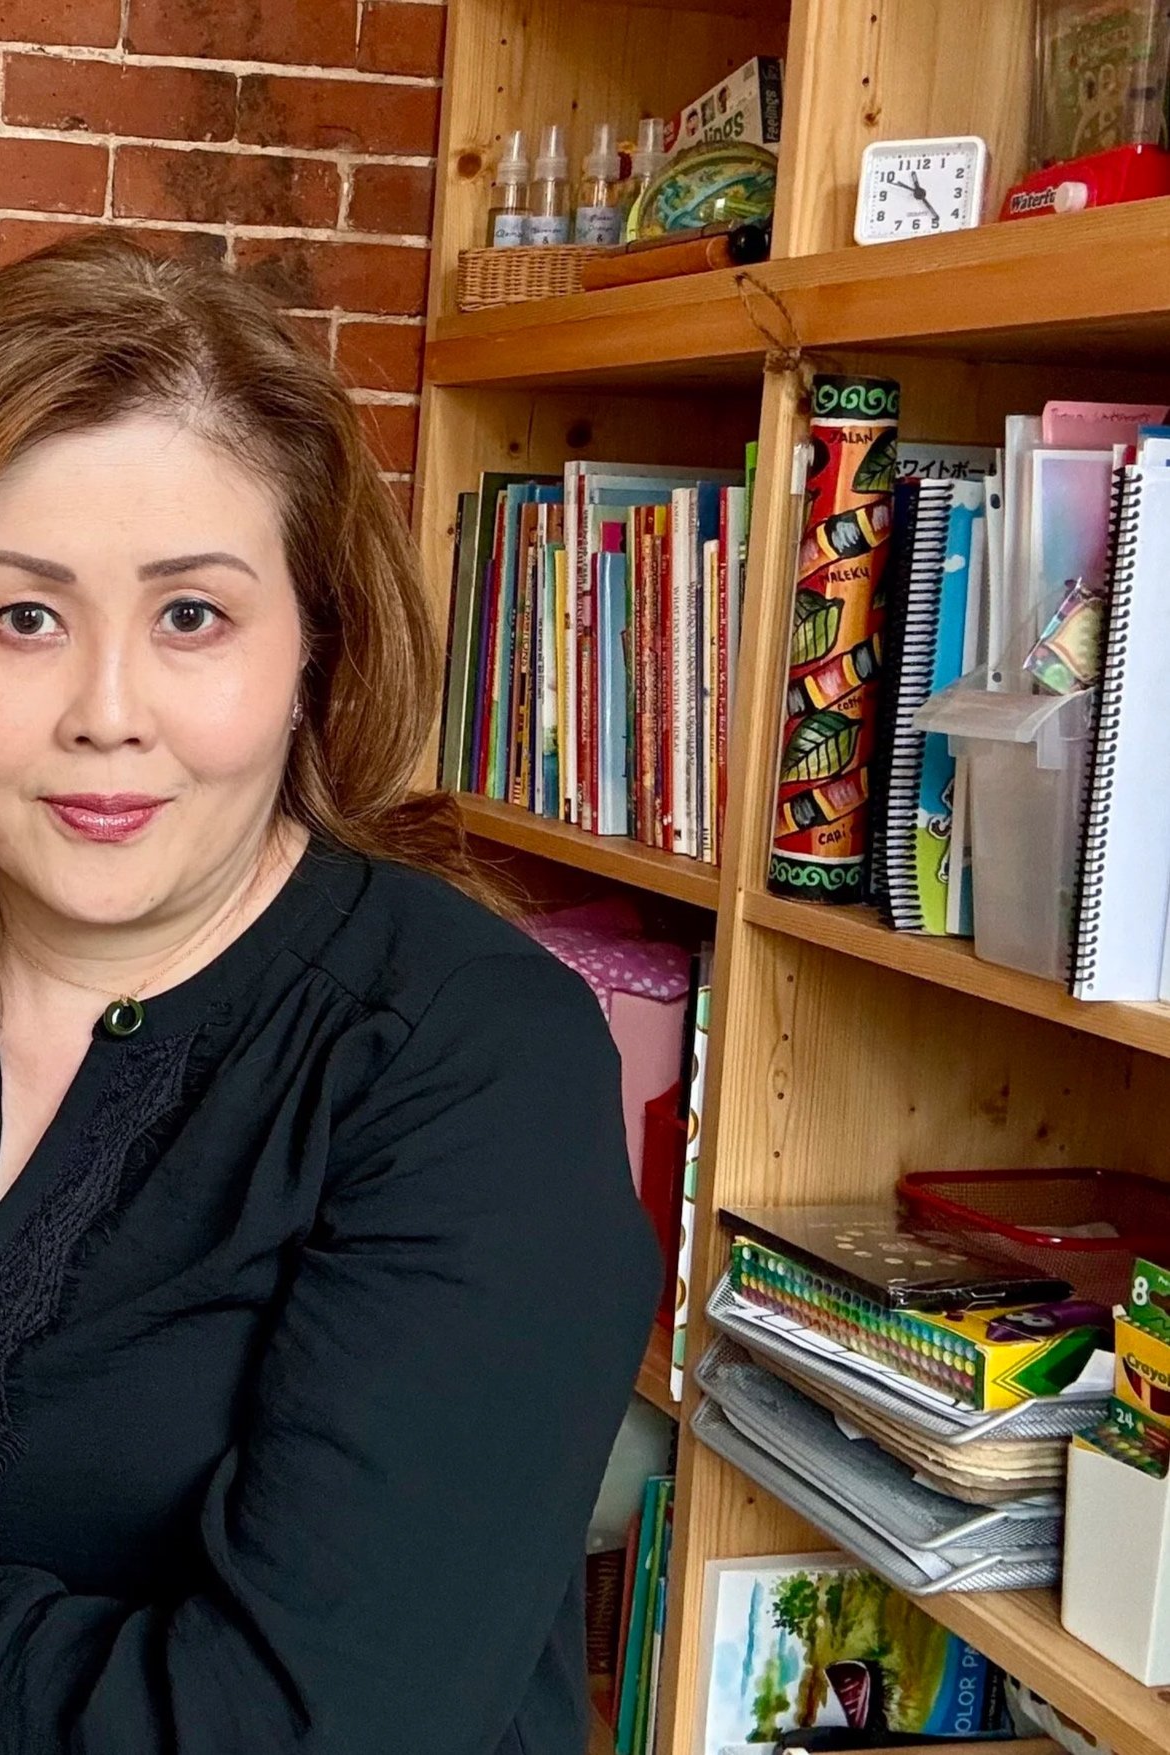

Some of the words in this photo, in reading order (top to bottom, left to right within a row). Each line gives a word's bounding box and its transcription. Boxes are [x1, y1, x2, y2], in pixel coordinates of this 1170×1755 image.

[703, 109, 744, 142] lings
[898, 159, 911, 171] 11
[916, 158, 931, 170] 12
[940, 157, 946, 169] 1
[879, 171, 895, 183] 10
[955, 168, 964, 179] 2
[878, 190, 887, 202] 9
[953, 187, 962, 199] 3
[876, 210, 885, 222] 8
[950, 208, 959, 219] 4
[894, 219, 902, 231] 7
[912, 218, 921, 230] 6
[930, 217, 940, 230] 5
[1132, 1276, 1148, 1306] 8
[1115, 1407, 1134, 1431] 24
[954, 1675, 977, 1733] OLOR
